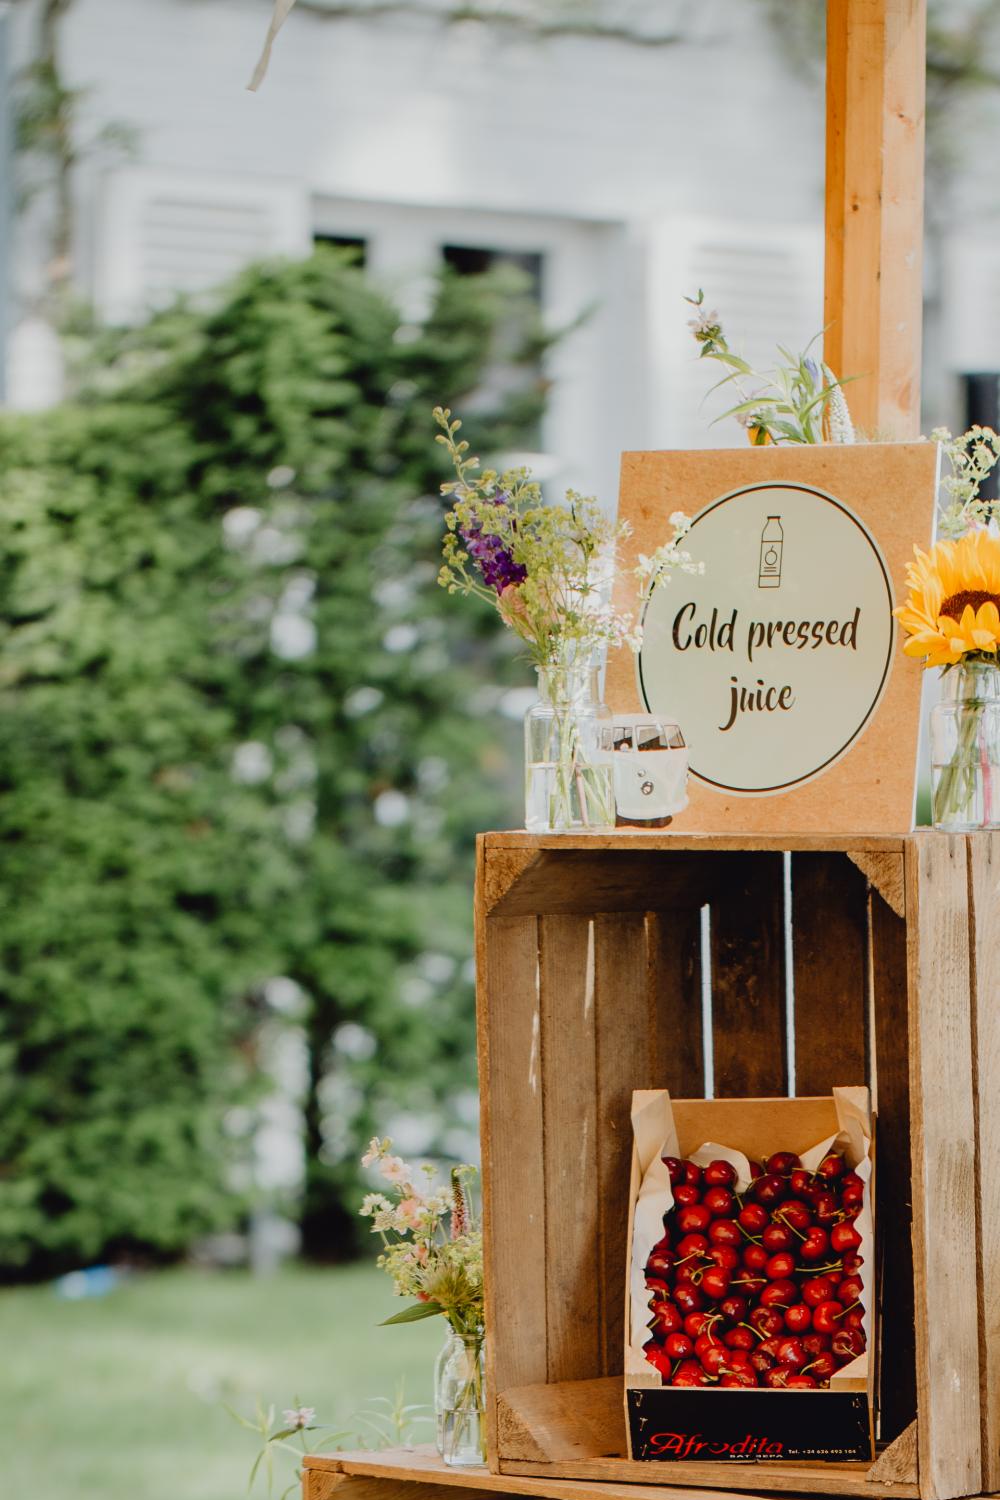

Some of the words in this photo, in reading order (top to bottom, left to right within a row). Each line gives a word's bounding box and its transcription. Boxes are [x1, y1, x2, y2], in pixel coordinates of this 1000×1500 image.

[672, 602, 738, 651] Cold
[747, 606, 861, 663] pressed
[719, 676, 796, 731] juice
